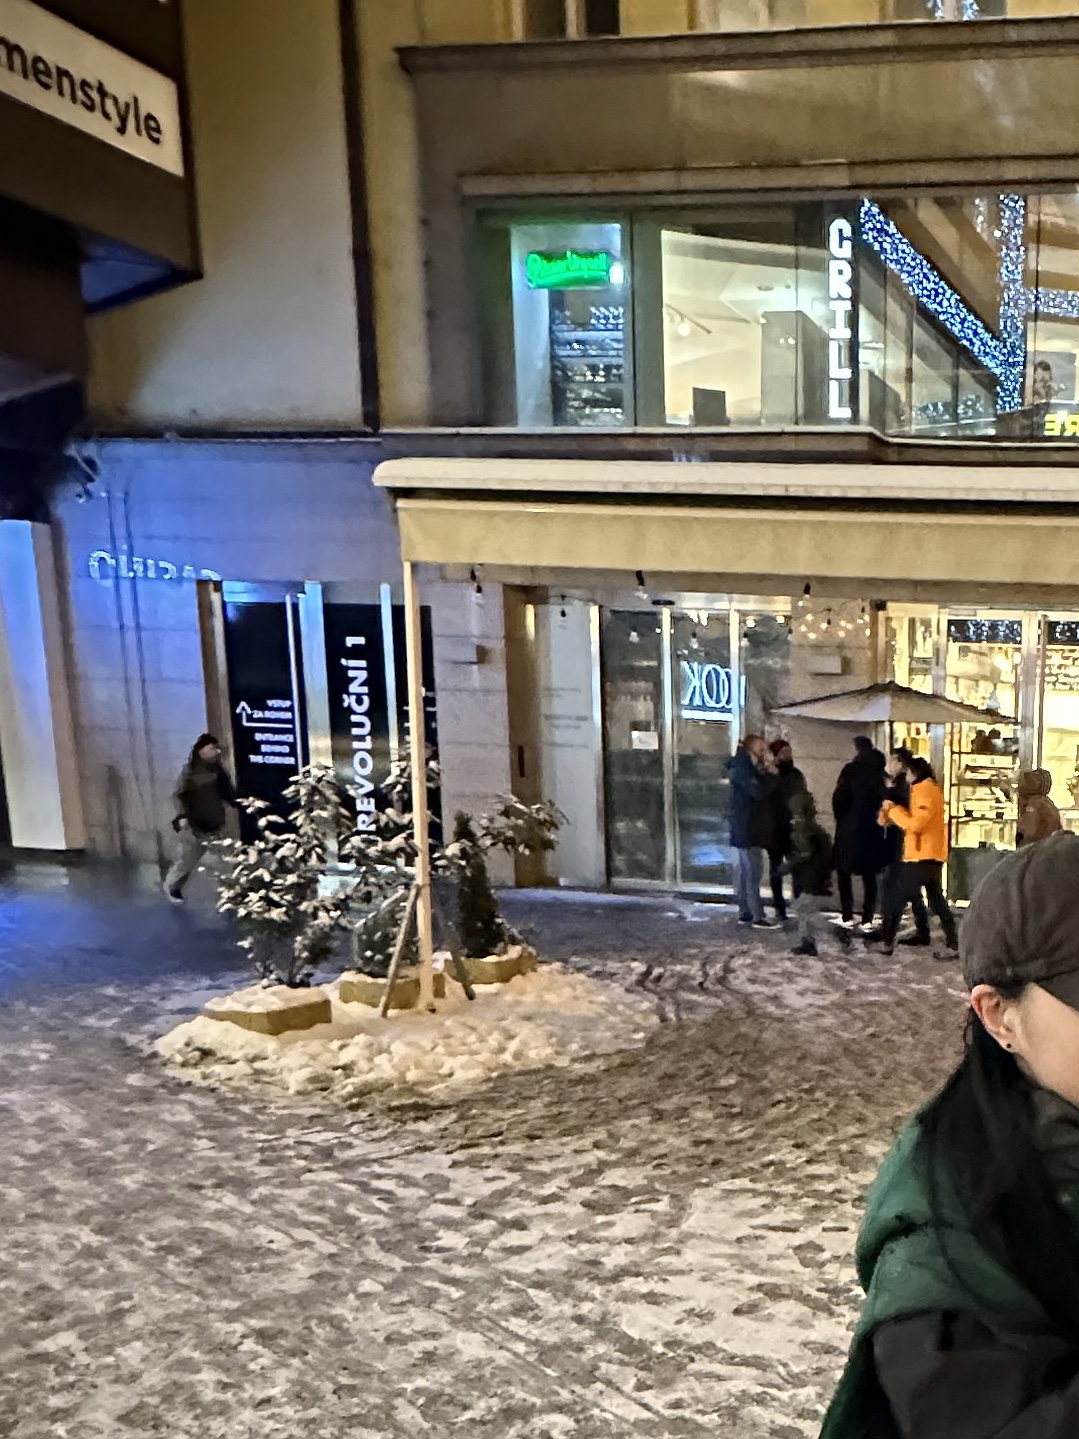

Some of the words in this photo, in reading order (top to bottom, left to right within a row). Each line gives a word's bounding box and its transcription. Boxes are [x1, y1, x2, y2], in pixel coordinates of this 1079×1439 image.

[0, 36, 162, 145] menstyle
[828, 218, 852, 419] GRILL
[345, 636, 366, 647] 1
[339, 657, 377, 832] REVOLUČNÍ
